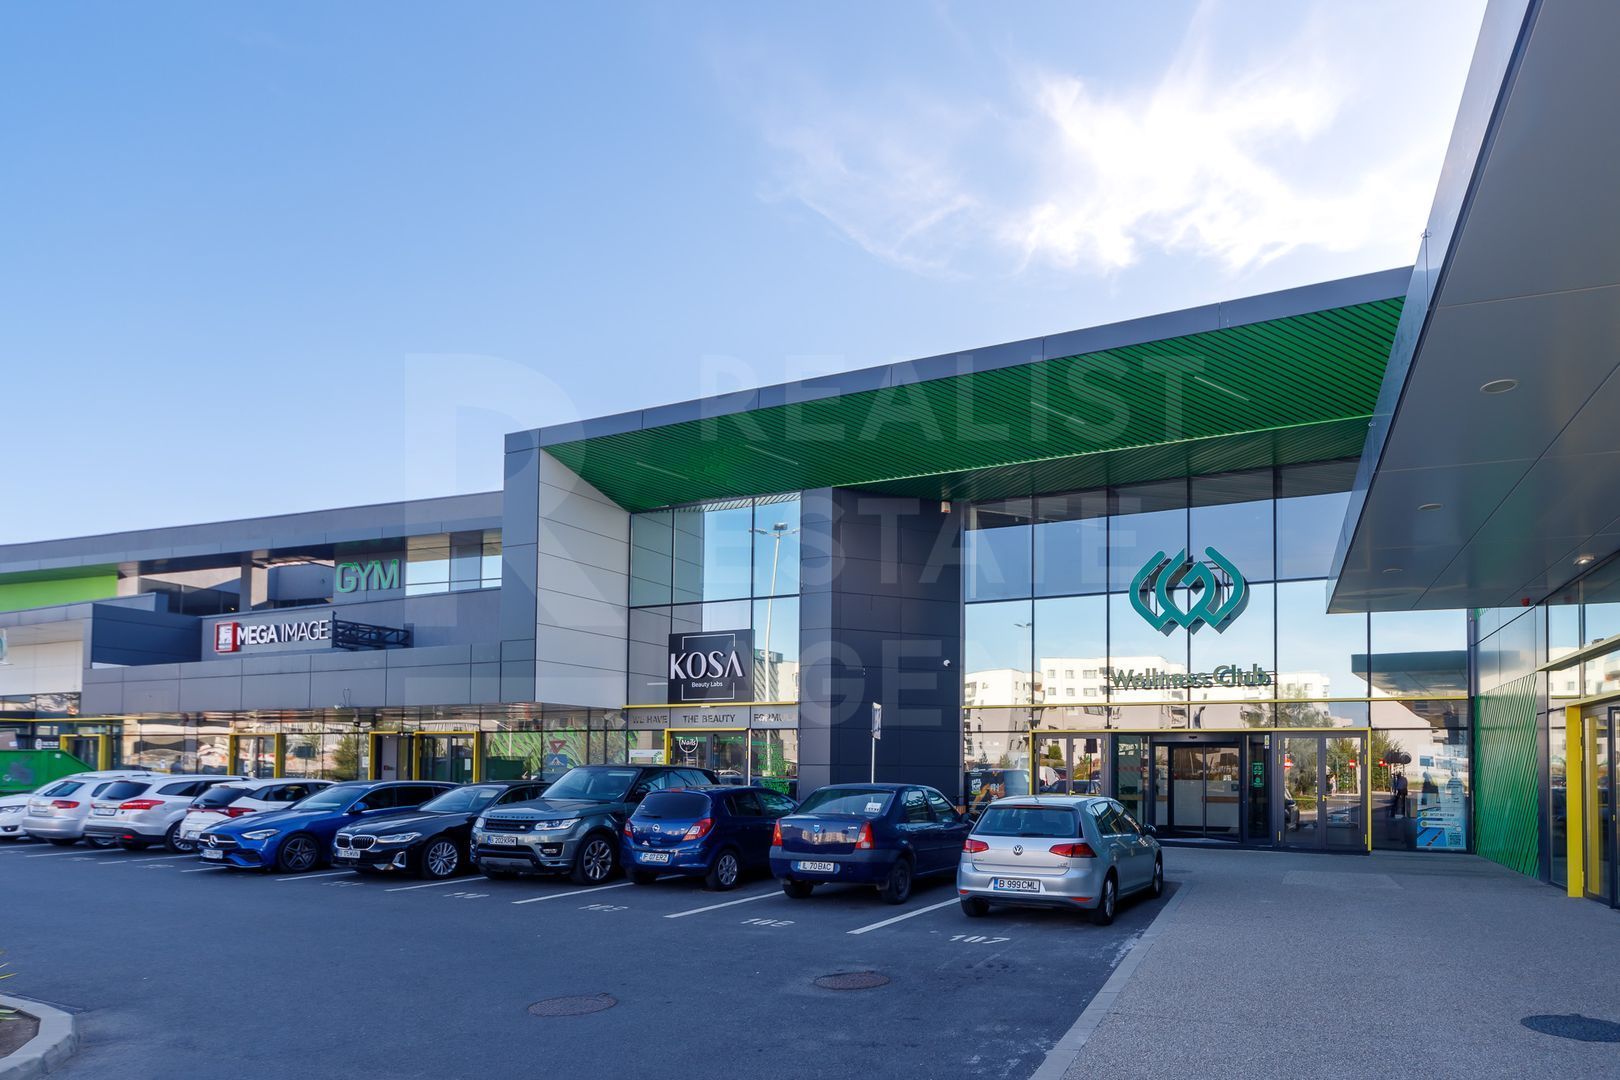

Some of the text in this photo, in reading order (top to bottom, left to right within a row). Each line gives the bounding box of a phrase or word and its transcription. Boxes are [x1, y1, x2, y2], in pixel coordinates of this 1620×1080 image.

[335, 559, 400, 593] GYM
[236, 619, 329, 645] MEGA IMAGE
[670, 650, 743, 680] KOSA
[1110, 664, 1268, 691] Wellness Club
[646, 714, 668, 724] HAVE
[683, 715, 699, 723] THE
[702, 714, 736, 723] BEAUTY
[998, 879, 1005, 888] B
